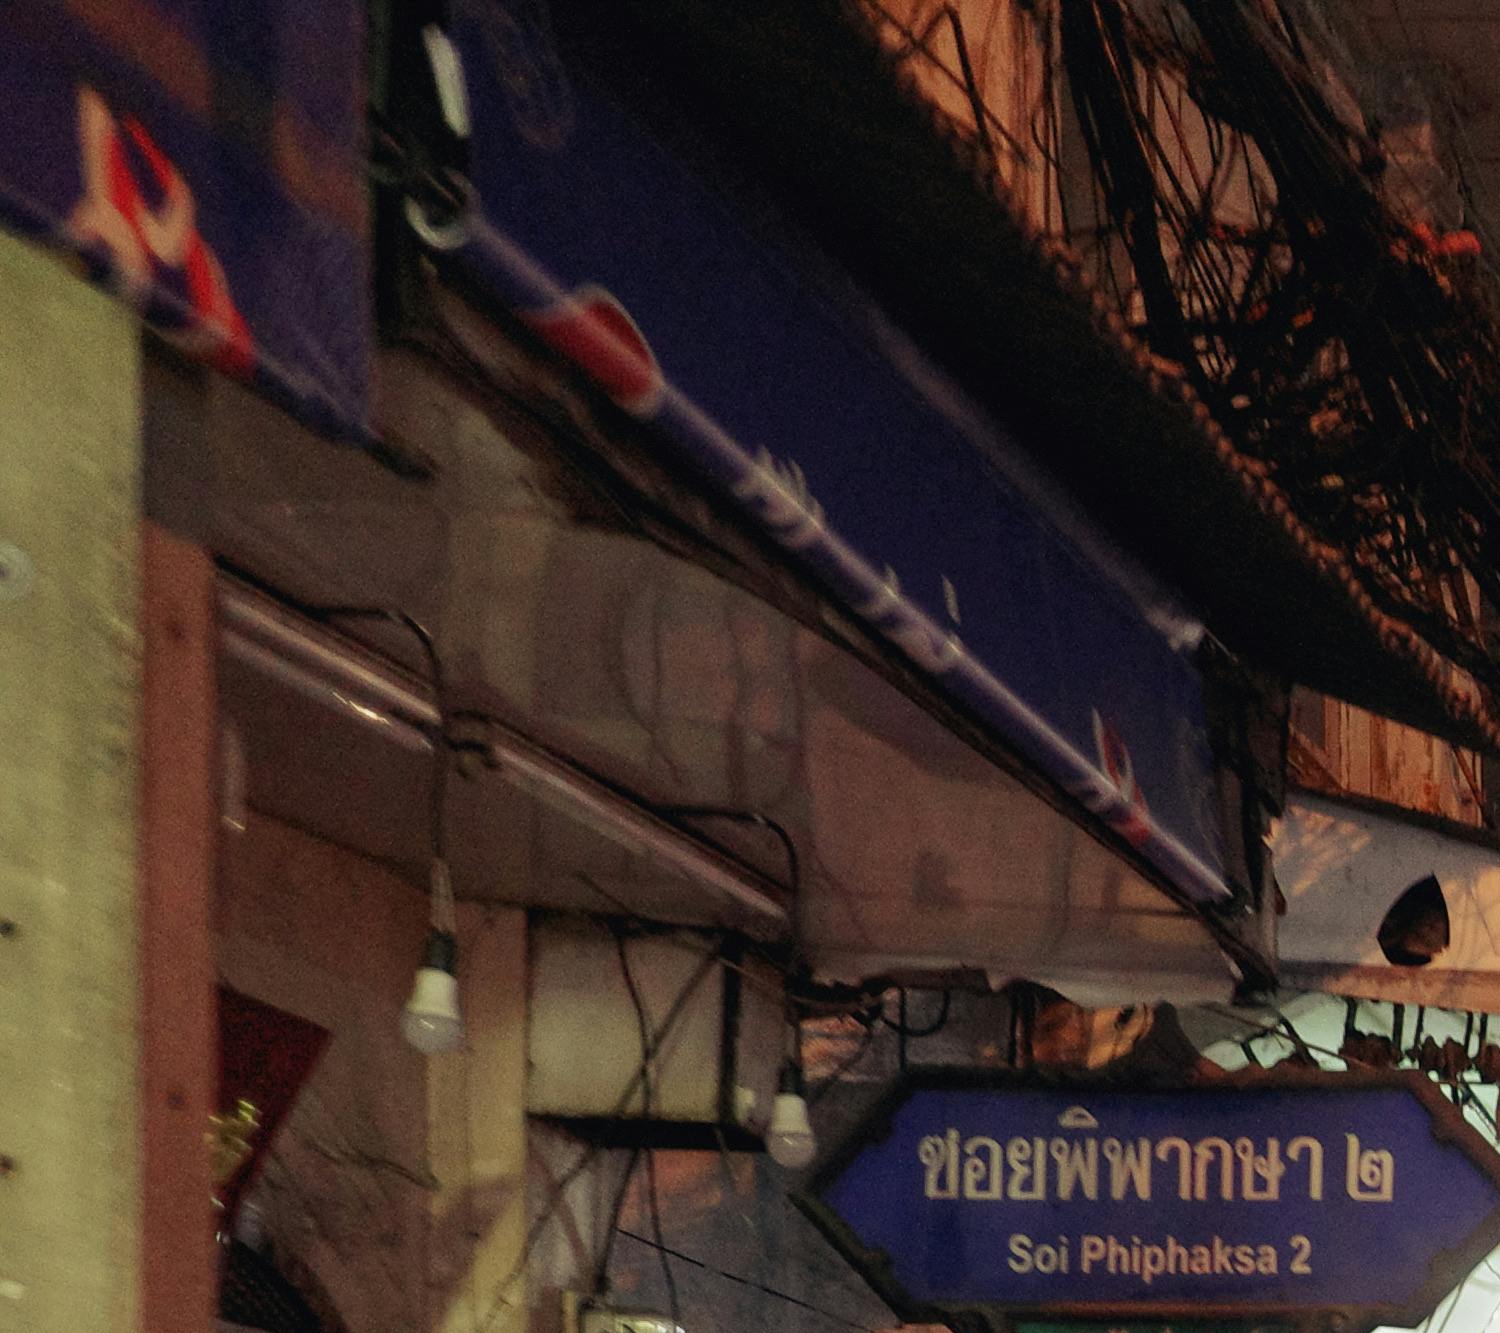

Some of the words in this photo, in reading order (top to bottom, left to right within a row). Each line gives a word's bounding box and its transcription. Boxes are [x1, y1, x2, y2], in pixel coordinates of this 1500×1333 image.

[917, 1106, 1323, 1202] ซอยพิพากษา
[1344, 1132, 1395, 1202] ๒
[1007, 1236, 1069, 1275] Soi
[1080, 1236, 1279, 1285] Phiphaksa
[1289, 1237, 1312, 1275] 2
